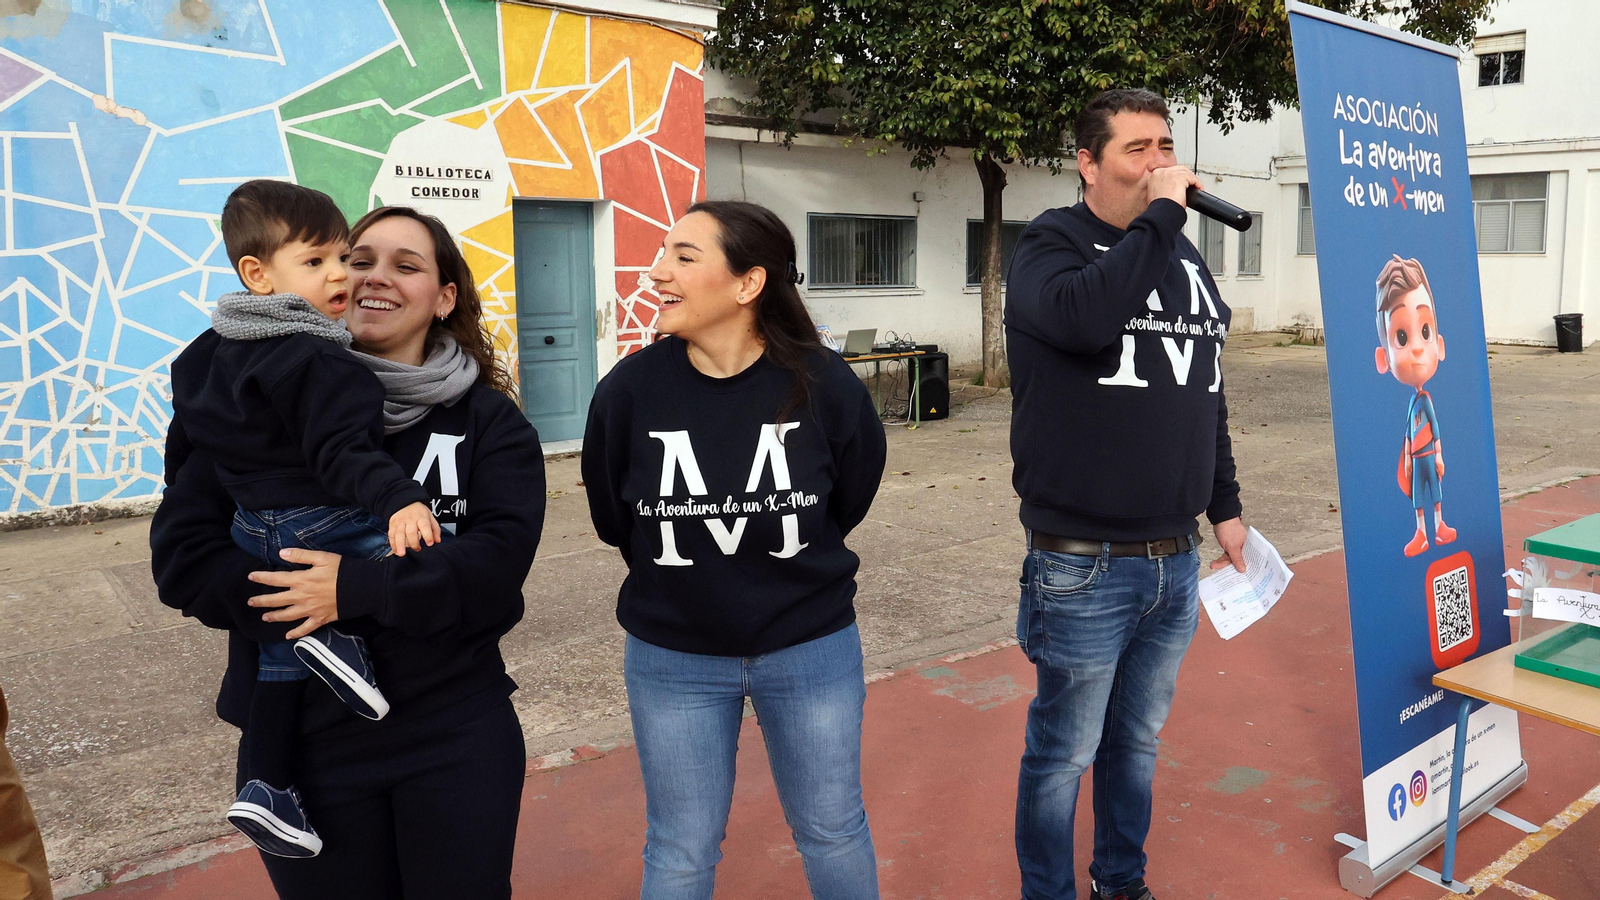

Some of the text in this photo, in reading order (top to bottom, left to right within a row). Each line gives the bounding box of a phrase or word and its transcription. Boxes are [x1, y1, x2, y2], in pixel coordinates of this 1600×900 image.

[1333, 92, 1438, 137] ASOCIACIÓN
[1339, 128, 1442, 182] La aventura
[395, 164, 491, 179] BIBLIOTECA
[411, 186, 479, 198] COMEDOR
[1344, 175, 1445, 216] de un X-men
[1124, 312, 1228, 341] ventura de un X-M
[430, 498, 467, 518] X-M
[636, 490, 819, 518] La Aventura de un X-Men
[649, 421, 810, 567] M
[1400, 689, 1445, 725] ¡ESCANÉAME!
